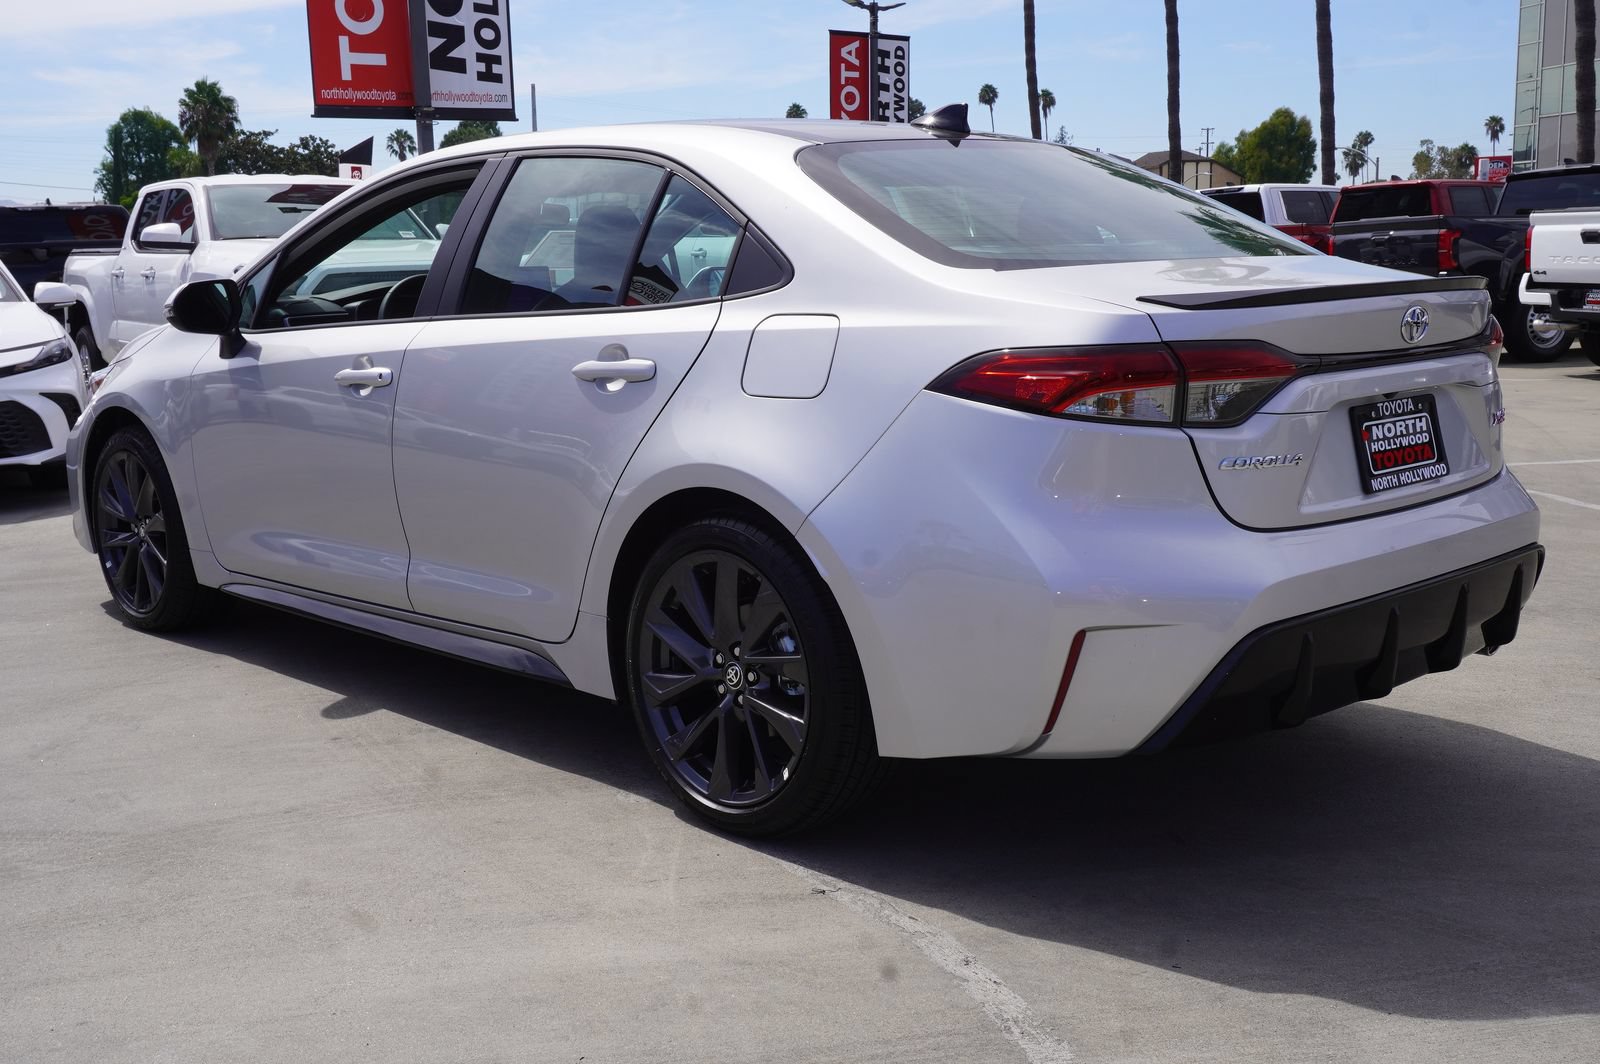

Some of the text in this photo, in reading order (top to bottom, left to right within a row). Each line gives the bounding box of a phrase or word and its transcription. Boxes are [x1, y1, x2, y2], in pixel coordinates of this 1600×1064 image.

[1377, 398, 1414, 416] TOYOTA
[1371, 417, 1427, 440] NORTH
[1370, 432, 1429, 453] HOLLYWOOD
[1218, 453, 1303, 471] COROLLA
[1374, 444, 1434, 469] TOYOTA
[1371, 463, 1447, 491] NORTH HOLLYWOOD
